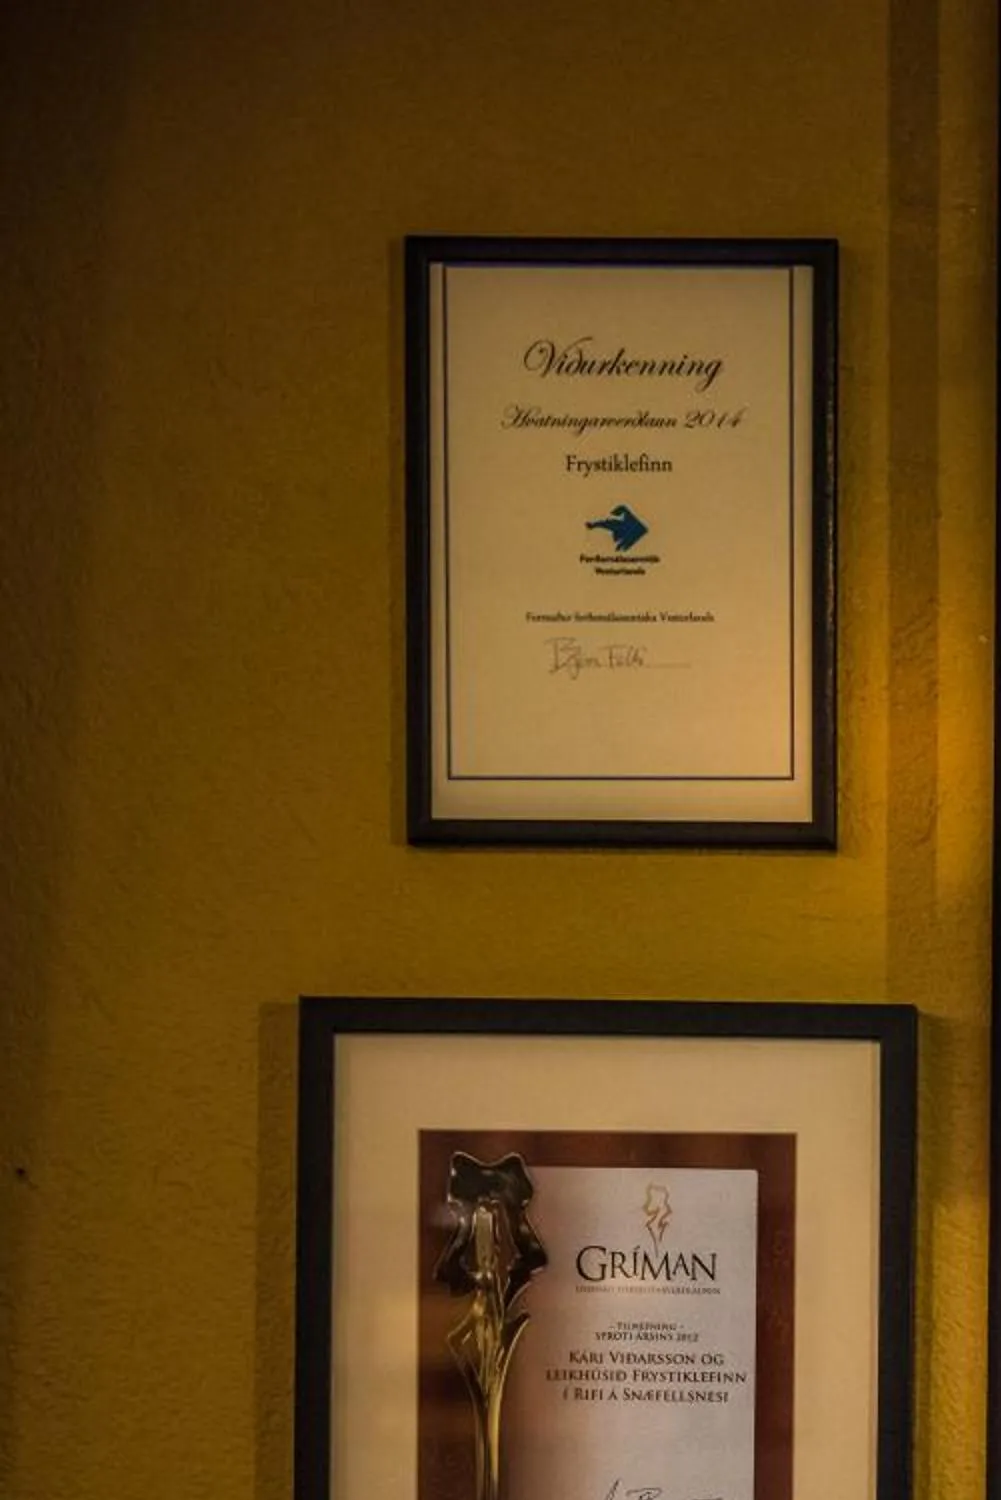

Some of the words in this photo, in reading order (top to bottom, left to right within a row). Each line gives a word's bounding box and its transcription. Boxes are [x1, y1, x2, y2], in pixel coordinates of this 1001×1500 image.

[565, 453, 674, 478] Frystiklefinn
[576, 1245, 718, 1282] GRÍMAN
[569, 1350, 604, 1364] KÁRI
[701, 1353, 725, 1365] OG
[633, 1369, 747, 1384] FRYSTIKLEFINN
[574, 1387, 604, 1401] RIFI
[623, 1388, 729, 1403] SNÆFELLSNESI
